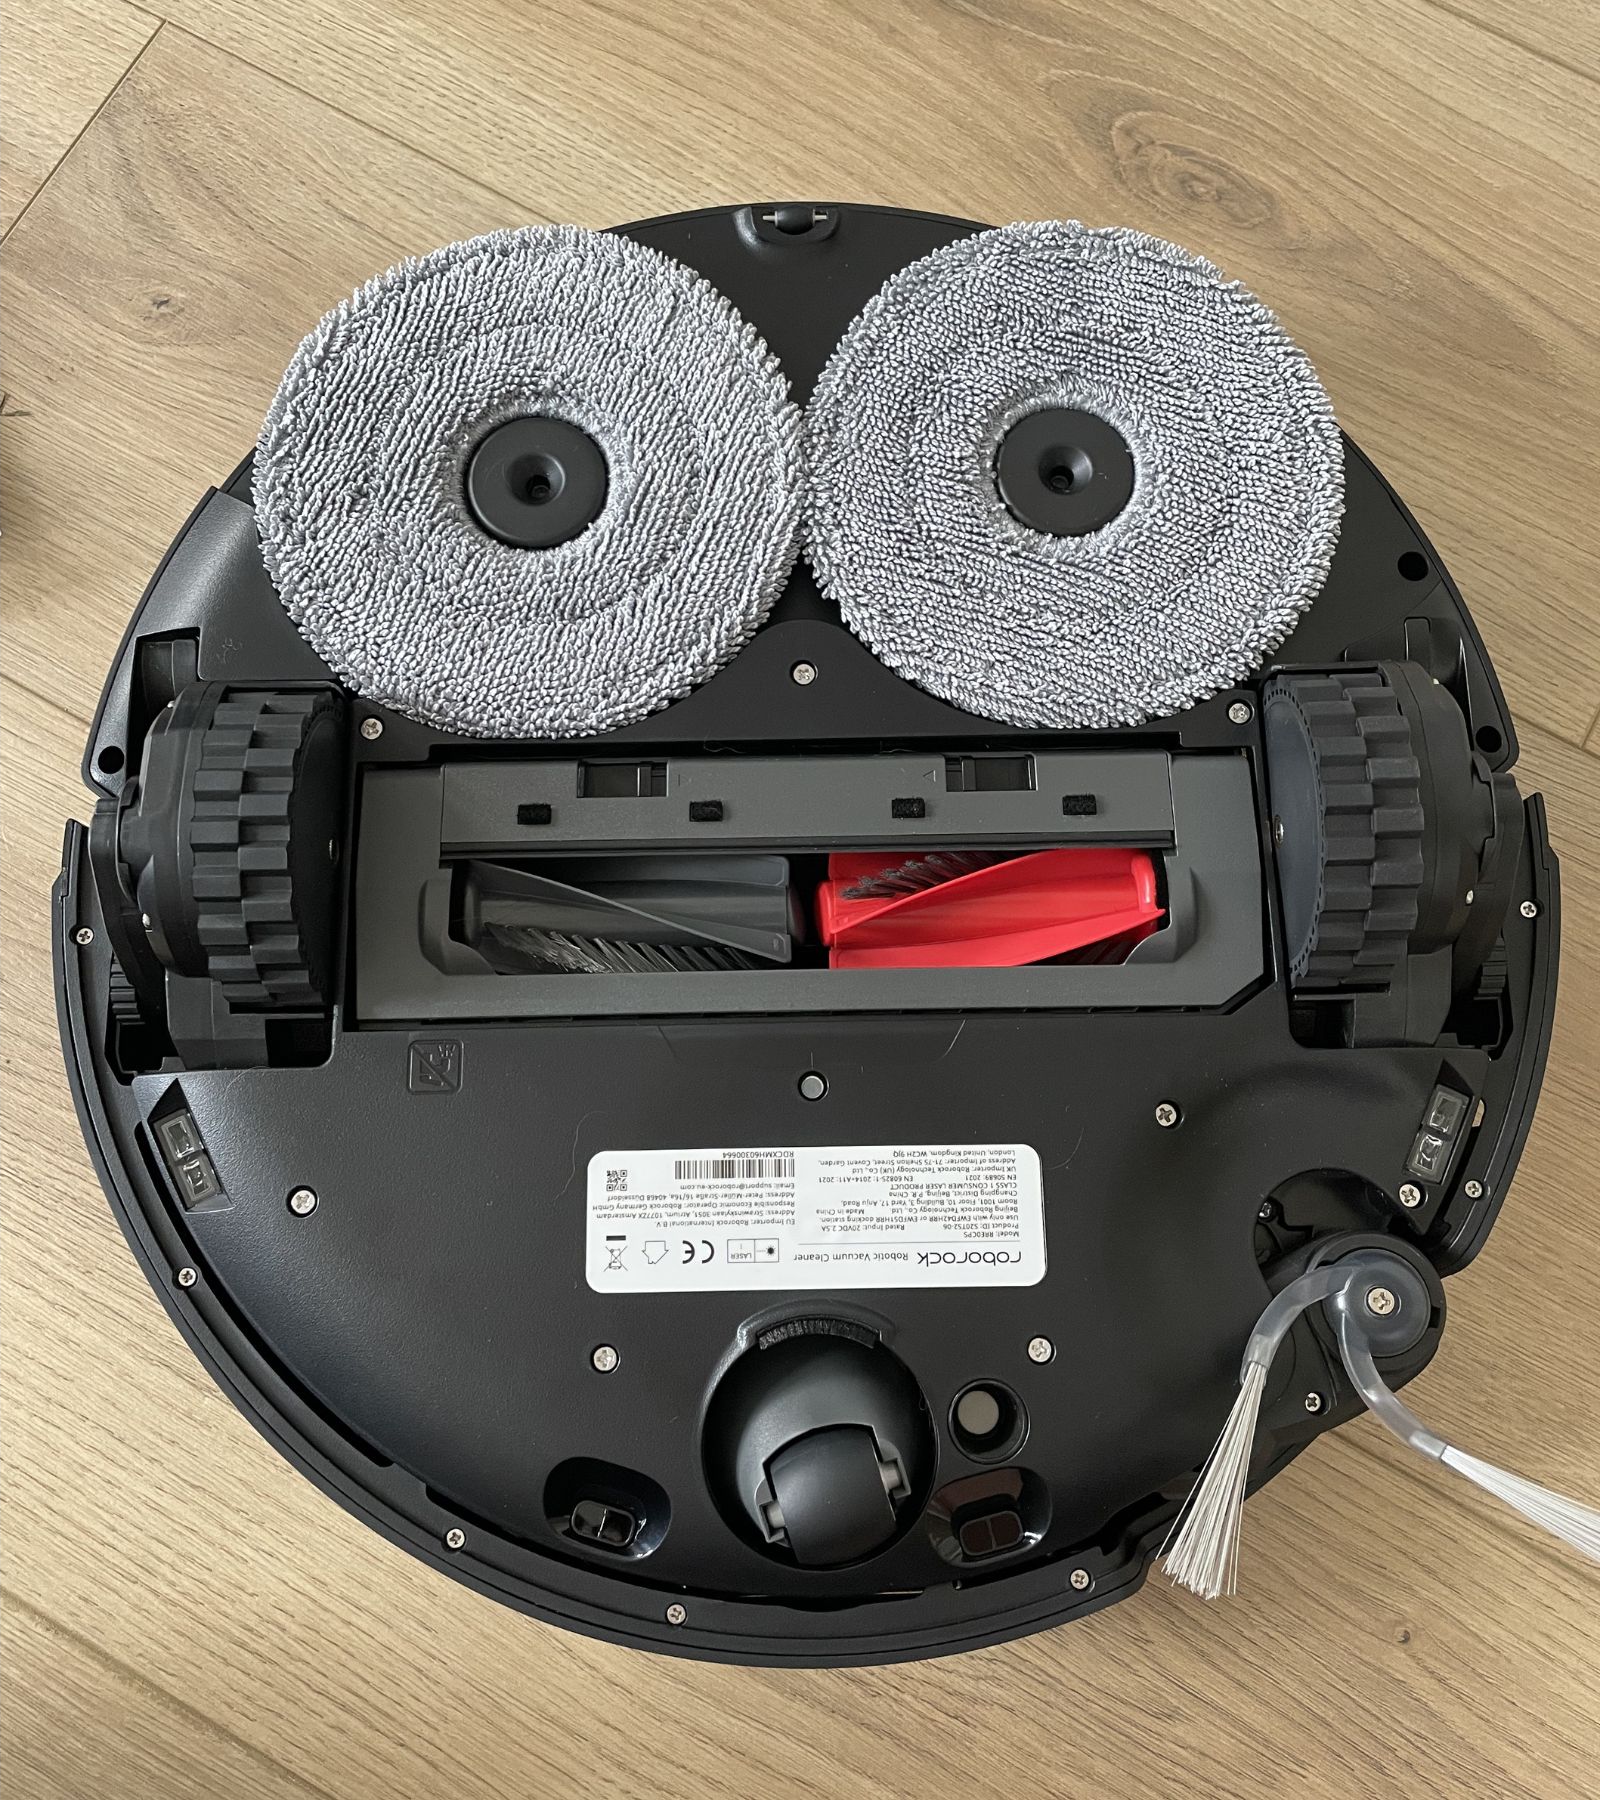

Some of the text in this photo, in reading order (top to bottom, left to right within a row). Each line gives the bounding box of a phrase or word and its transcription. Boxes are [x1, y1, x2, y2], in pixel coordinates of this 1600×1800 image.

[963, 1150, 986, 1158] United
[988, 1158, 1016, 1166] Address
[996, 1182, 1017, 1190] CLASS
[616, 1203, 647, 1211] Germany
[916, 1199, 944, 1207] Building
[794, 1252, 908, 1263] Robotic Vacuum Cleaner
[917, 1251, 1021, 1267] roborock
